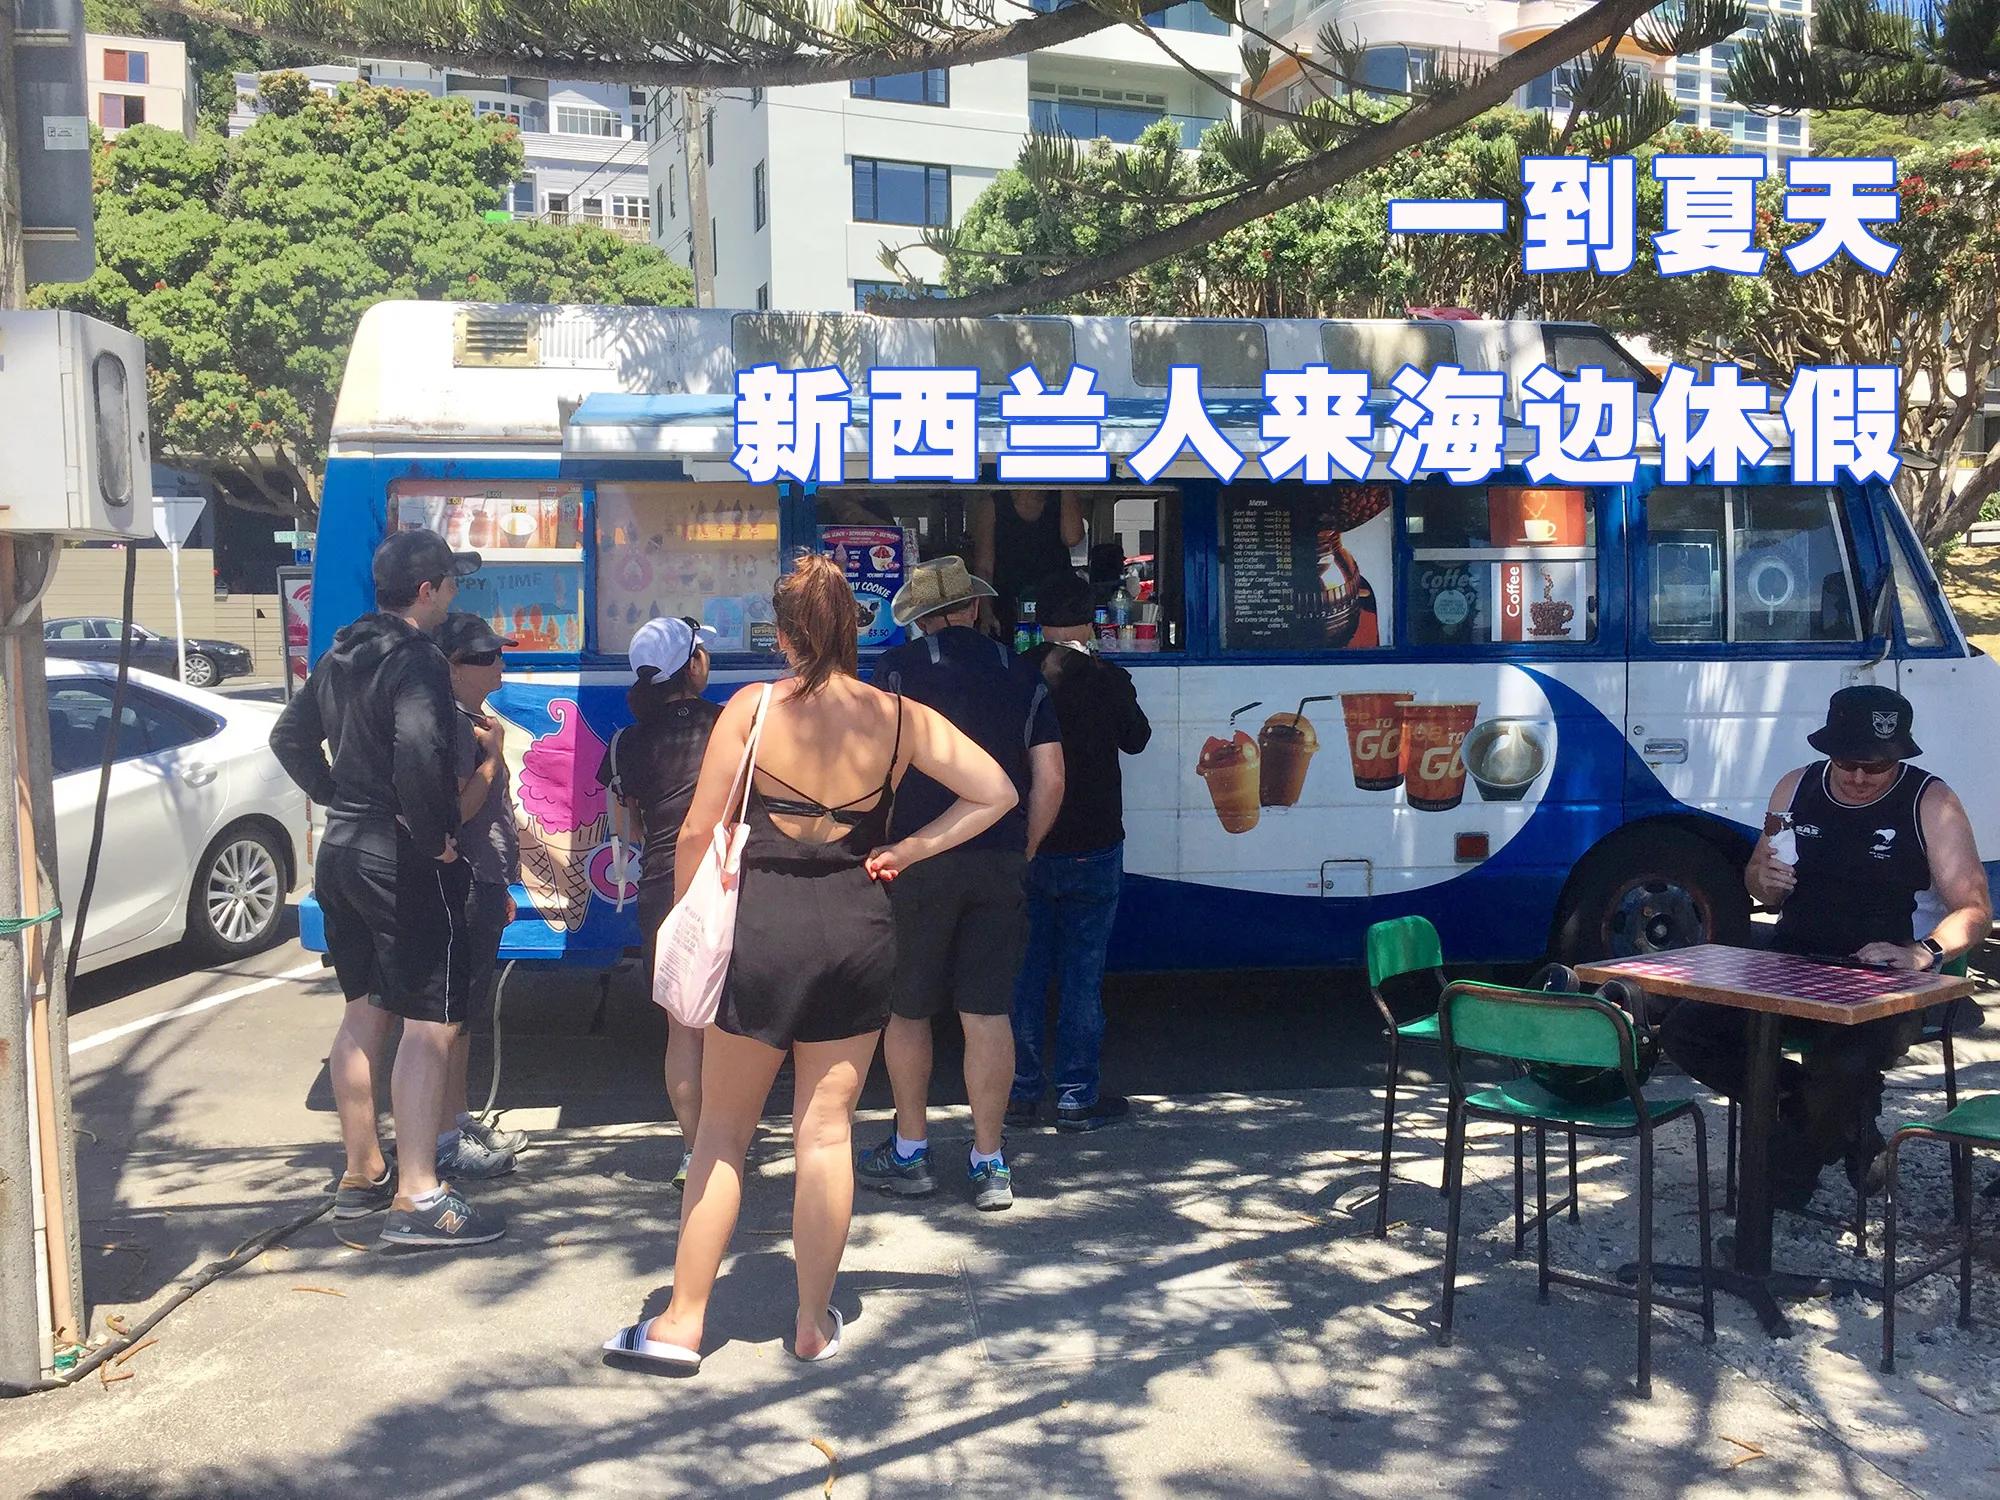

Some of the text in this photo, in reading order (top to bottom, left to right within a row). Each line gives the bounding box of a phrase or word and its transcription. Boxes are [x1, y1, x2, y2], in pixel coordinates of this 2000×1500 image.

[1248, 499, 1268, 507] Menu
[861, 581, 892, 598] COOKIE
[1506, 565, 1520, 617] Coffee
[1375, 718, 1394, 729] TO
[1356, 729, 1401, 760] GO
[433, 1209, 468, 1235] N
